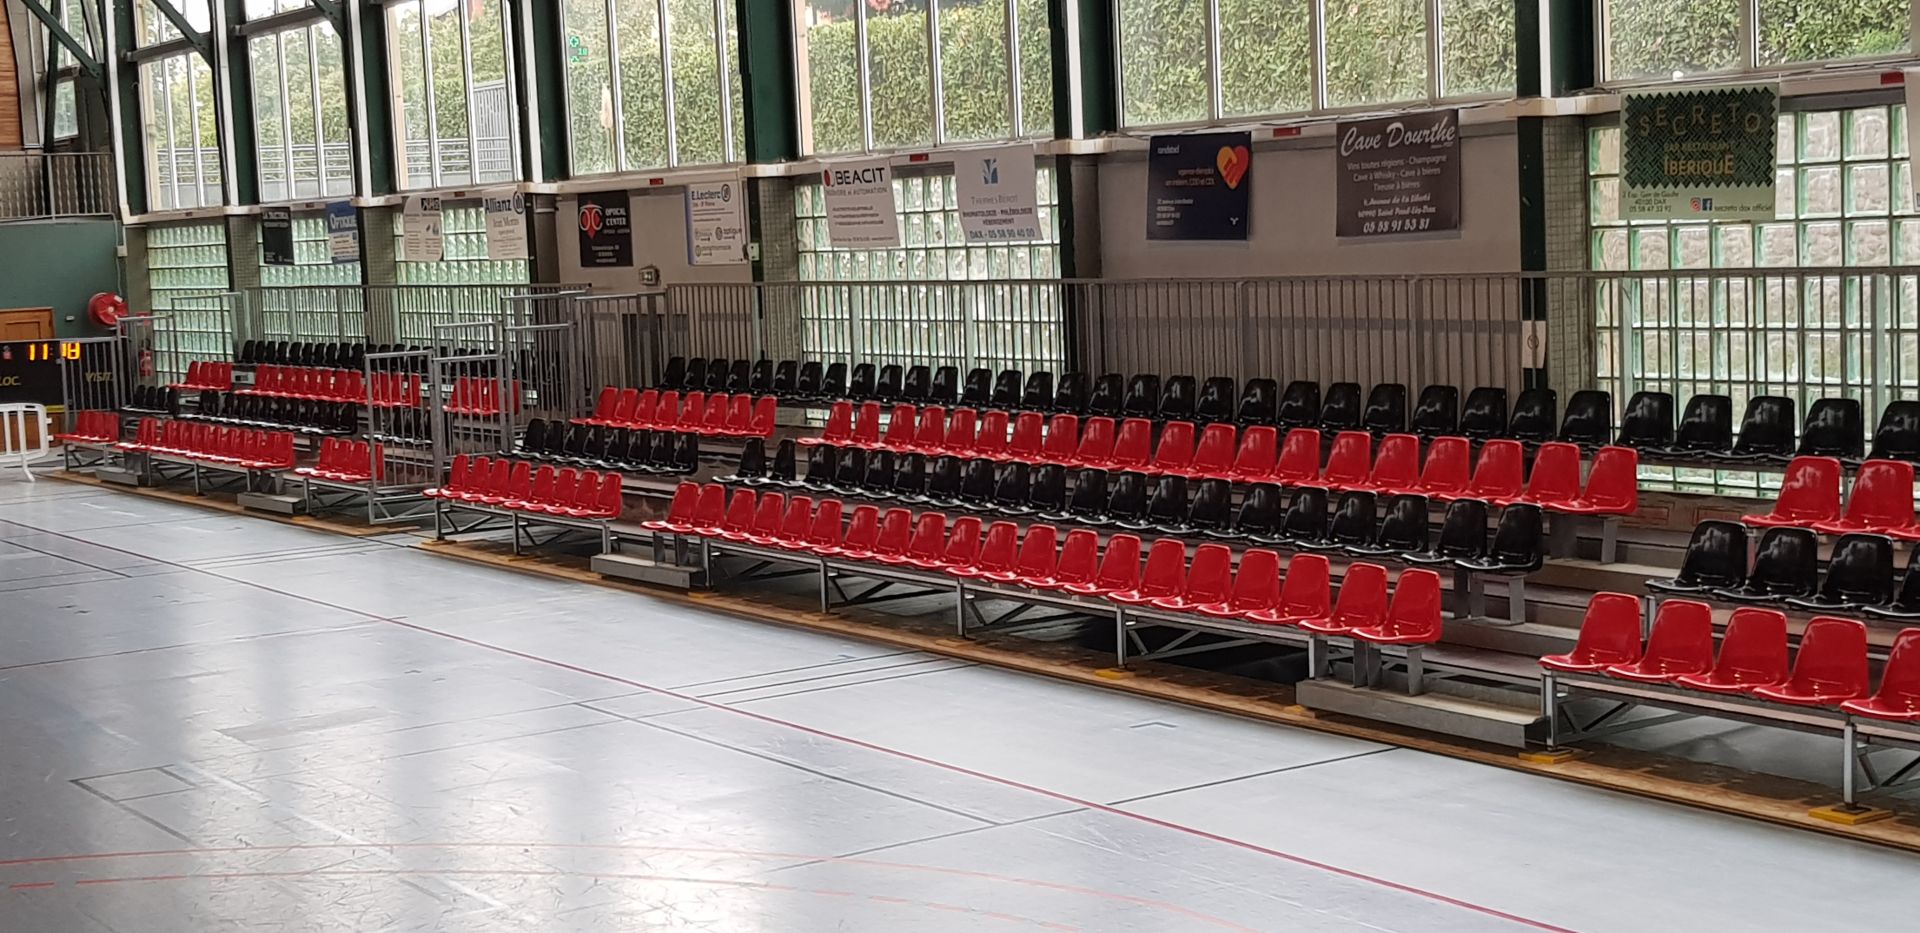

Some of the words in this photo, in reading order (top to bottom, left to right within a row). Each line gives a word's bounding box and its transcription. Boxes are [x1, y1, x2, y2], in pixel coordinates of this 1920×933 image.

[1638, 102, 1761, 136] SECRETO
[1341, 126, 1382, 157] Cave
[1386, 116, 1456, 148] Dourthe
[835, 167, 885, 185] BEACIT
[485, 198, 511, 214] Allianz
[605, 216, 627, 226] CENTER
[969, 230, 983, 239] DAX
